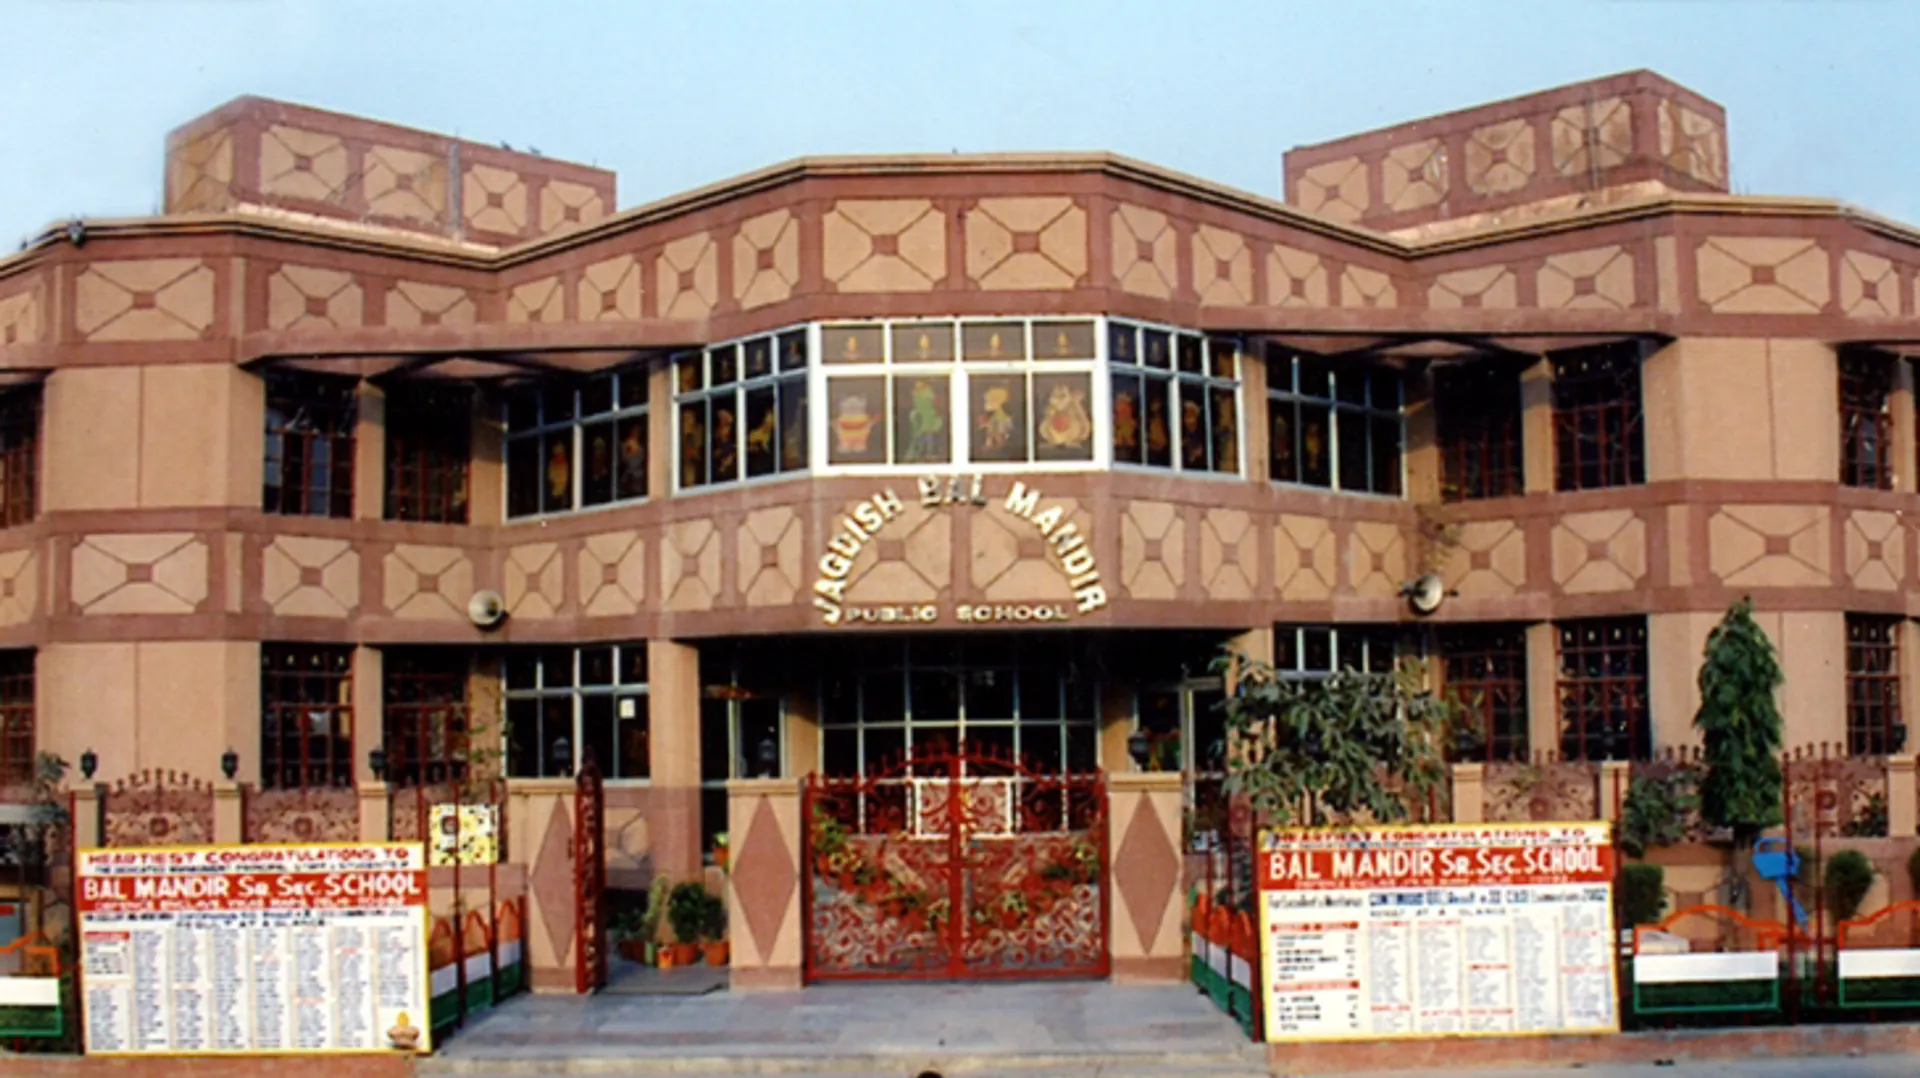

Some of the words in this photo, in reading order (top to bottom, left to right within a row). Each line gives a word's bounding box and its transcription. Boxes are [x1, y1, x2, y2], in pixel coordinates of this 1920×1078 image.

[813, 486, 904, 625] JAGDISH
[918, 473, 988, 509] BAL
[1004, 481, 1108, 614] MANDIR
[845, 605, 938, 622] PUBLIC
[955, 604, 1070, 622] SCHOOL
[384, 847, 410, 860] TO
[1269, 851, 1322, 880] BAL
[1332, 849, 1435, 878] MANDIR
[1523, 844, 1605, 874] SCHOOL
[84, 875, 128, 900] BAL
[134, 874, 231, 898] MANDIR
[324, 871, 422, 896] SCHOOL
